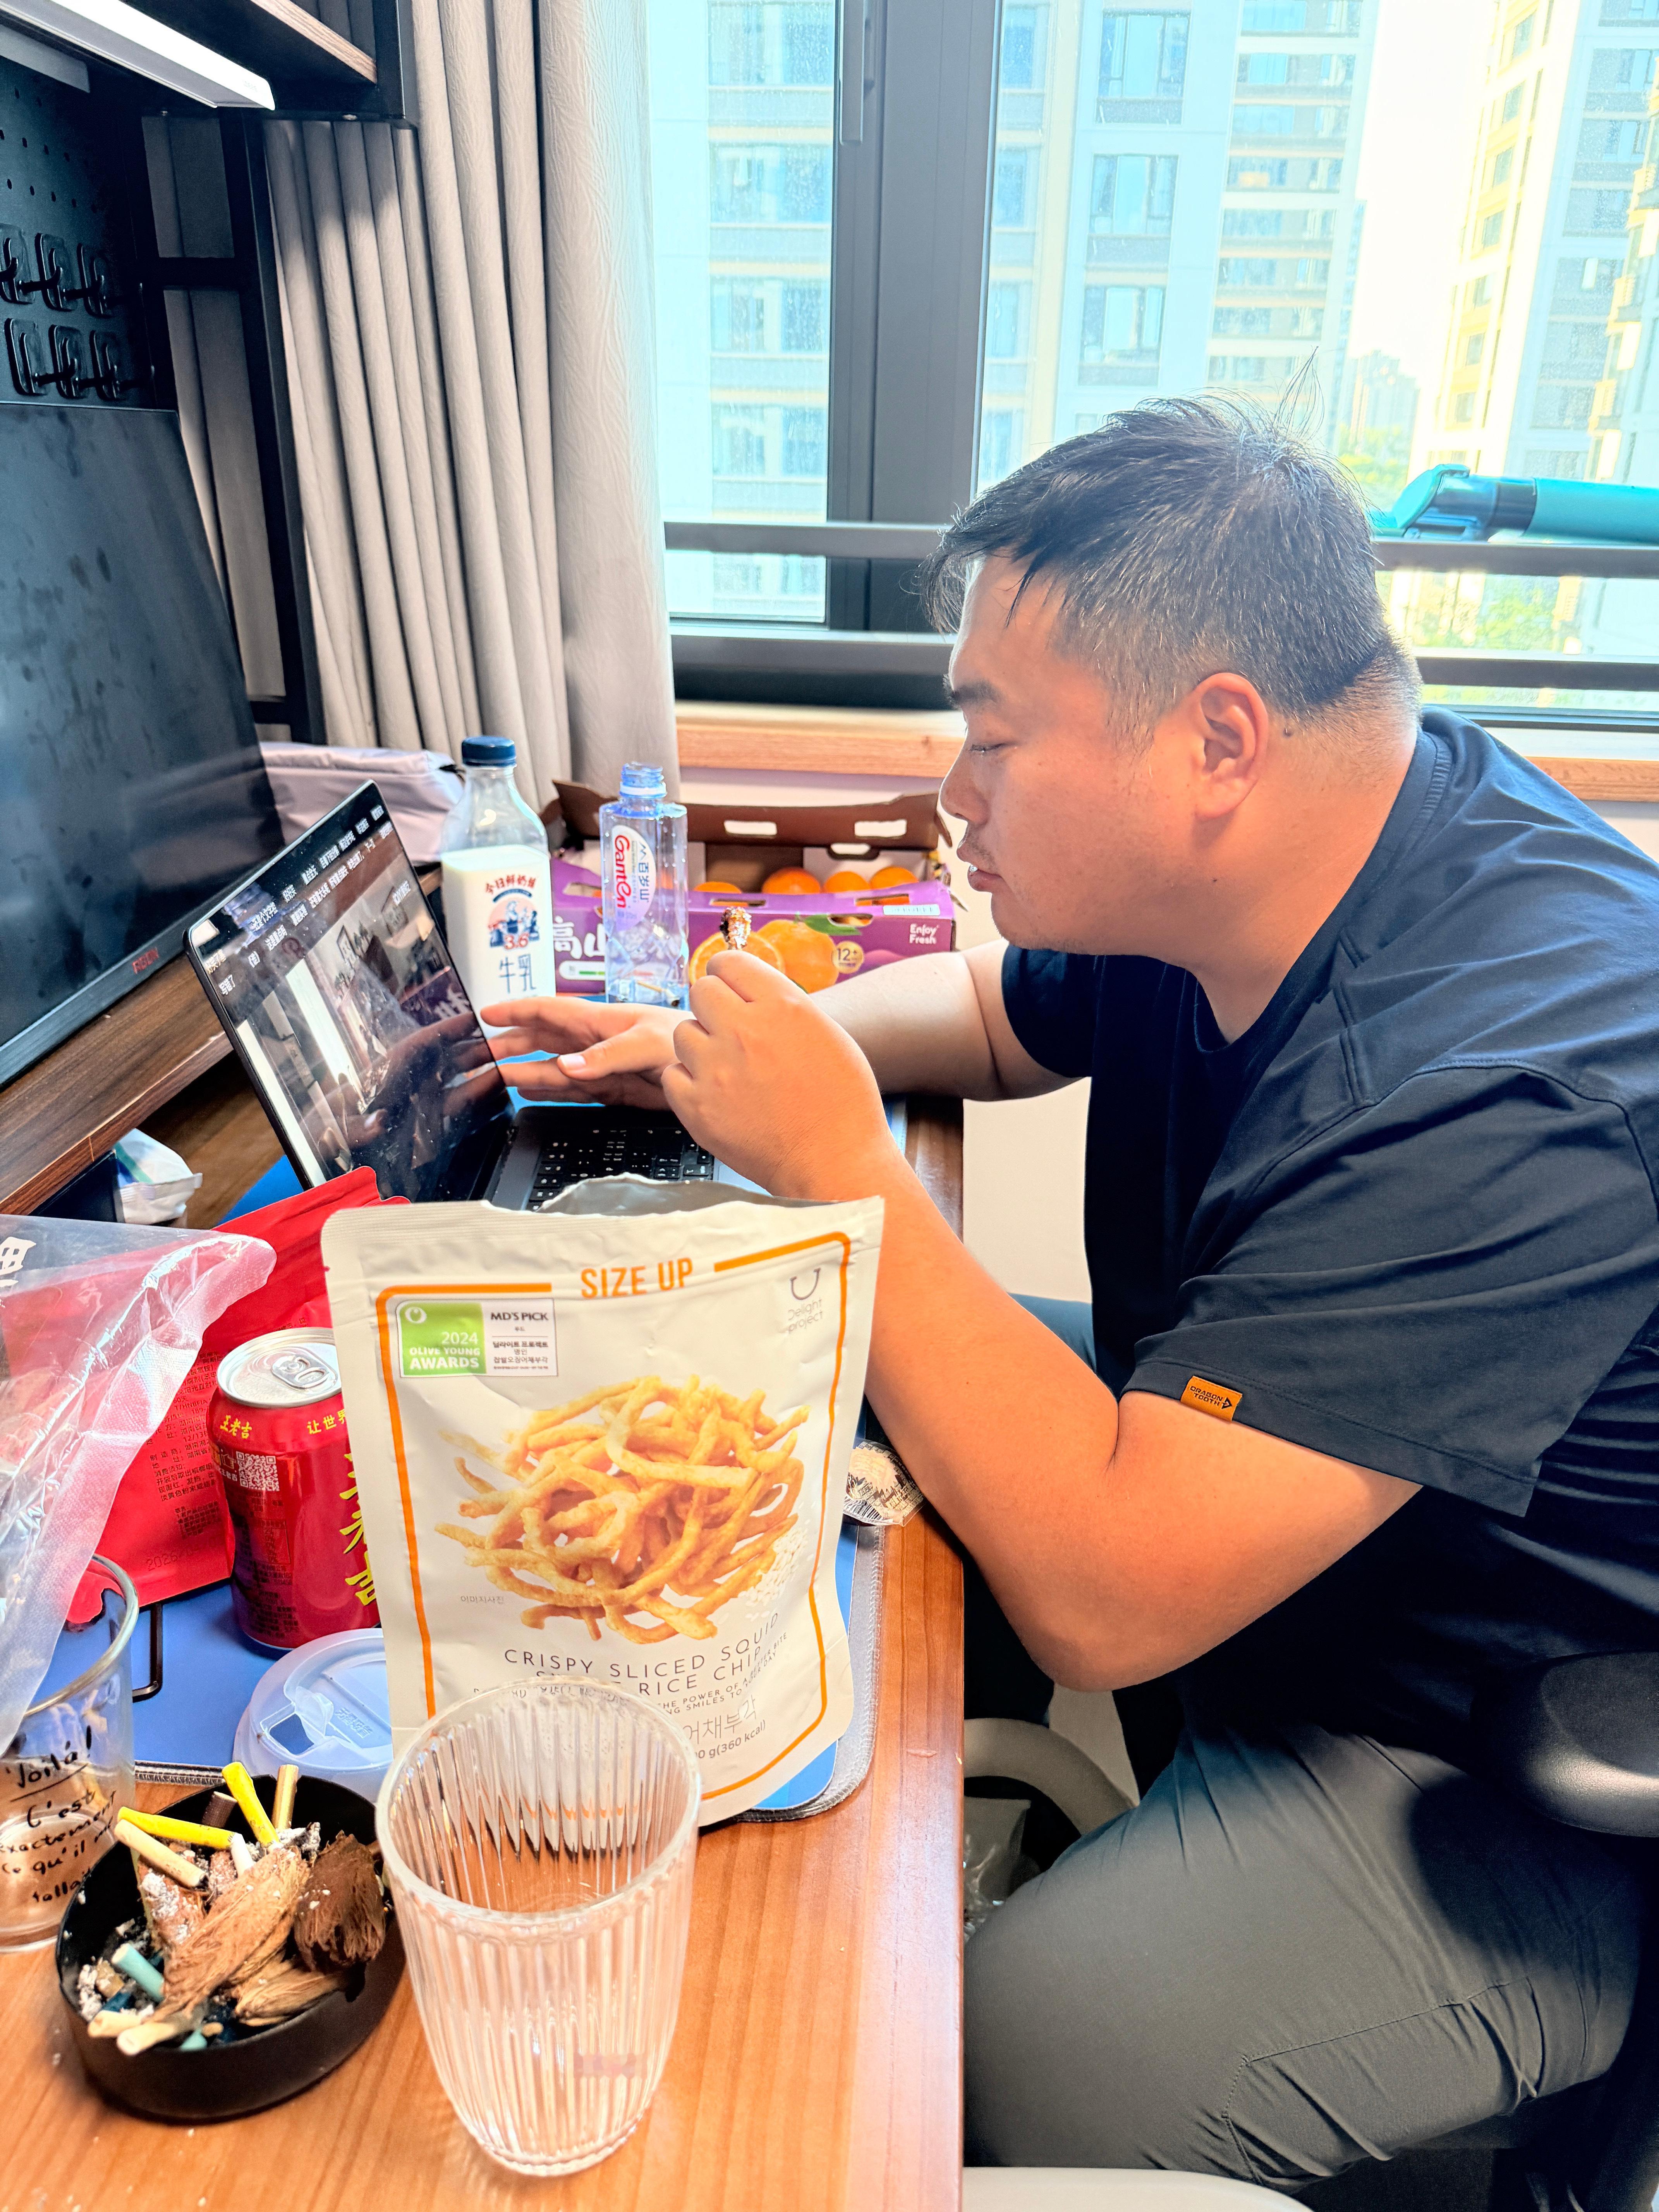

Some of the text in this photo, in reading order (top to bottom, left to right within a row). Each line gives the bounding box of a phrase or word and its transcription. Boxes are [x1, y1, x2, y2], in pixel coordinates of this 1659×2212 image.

[638, 862, 650, 900] 百岁山
[503, 933, 529, 950] 3.6
[910, 923, 938, 936] Enjoy
[910, 933, 937, 944] Fresh
[498, 953, 536, 994] 牛乳
[581, 1257, 693, 1299] SIZE UP
[788, 1310, 823, 1334] project
[441, 1331, 478, 1345] 2024
[409, 1347, 480, 1356] OLIVE YOUNG
[409, 1357, 479, 1370] AWARDS
[1190, 1386, 1223, 1401] DRAGON
[1194, 1393, 1219, 1406] TOOTH
[220, 1415, 252, 1439] 王老吉
[461, 1595, 503, 1604] 이미지사진
[505, 1650, 592, 1673] CRISPY
[610, 1655, 704, 1678] SLICED
[721, 1613, 778, 1661] SQUID
[639, 1674, 697, 1696] RICE
[714, 1646, 761, 1680] CHIP
[683, 1690, 720, 1704] POWER
[726, 1683, 738, 1692] OF
[774, 1632, 787, 1649] BITE
[687, 1695, 724, 1711] SMILES
[731, 1688, 742, 1698] TO
[764, 1650, 776, 1667] DAY
[709, 1737, 742, 1758] g(360
[745, 1719, 766, 1742] kcal)
